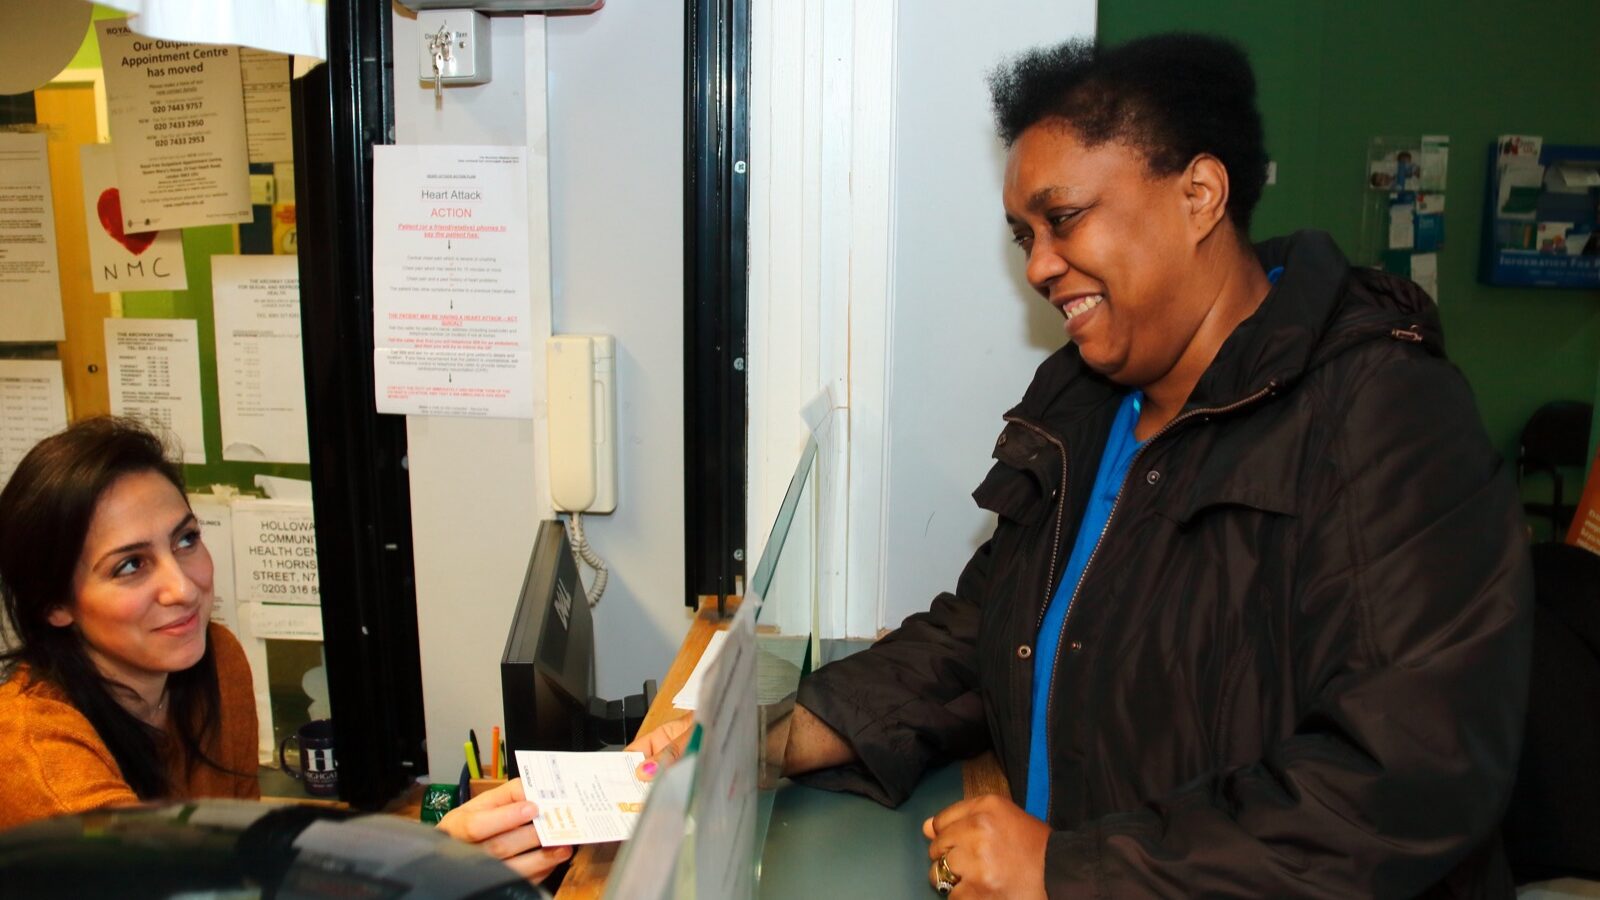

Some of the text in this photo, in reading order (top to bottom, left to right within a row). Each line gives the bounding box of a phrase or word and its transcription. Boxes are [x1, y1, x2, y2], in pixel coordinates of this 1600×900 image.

[133, 41, 152, 52] Our
[121, 48, 228, 67] Appointment Centre
[147, 63, 204, 77] has moved
[153, 101, 203, 114] 020 7443 9757
[154, 119, 204, 131] 020 7433 2950
[155, 136, 205, 148] 020 7433 2953
[421, 190, 482, 200] Heart Attack
[430, 208, 472, 218] ACTION
[249, 546, 292, 556] HEALTH
[262, 560, 273, 568] 11
[303, 572, 316, 582] N7
[262, 584, 287, 593] 0203
[290, 584, 308, 593] 316
[306, 748, 335, 772] H
